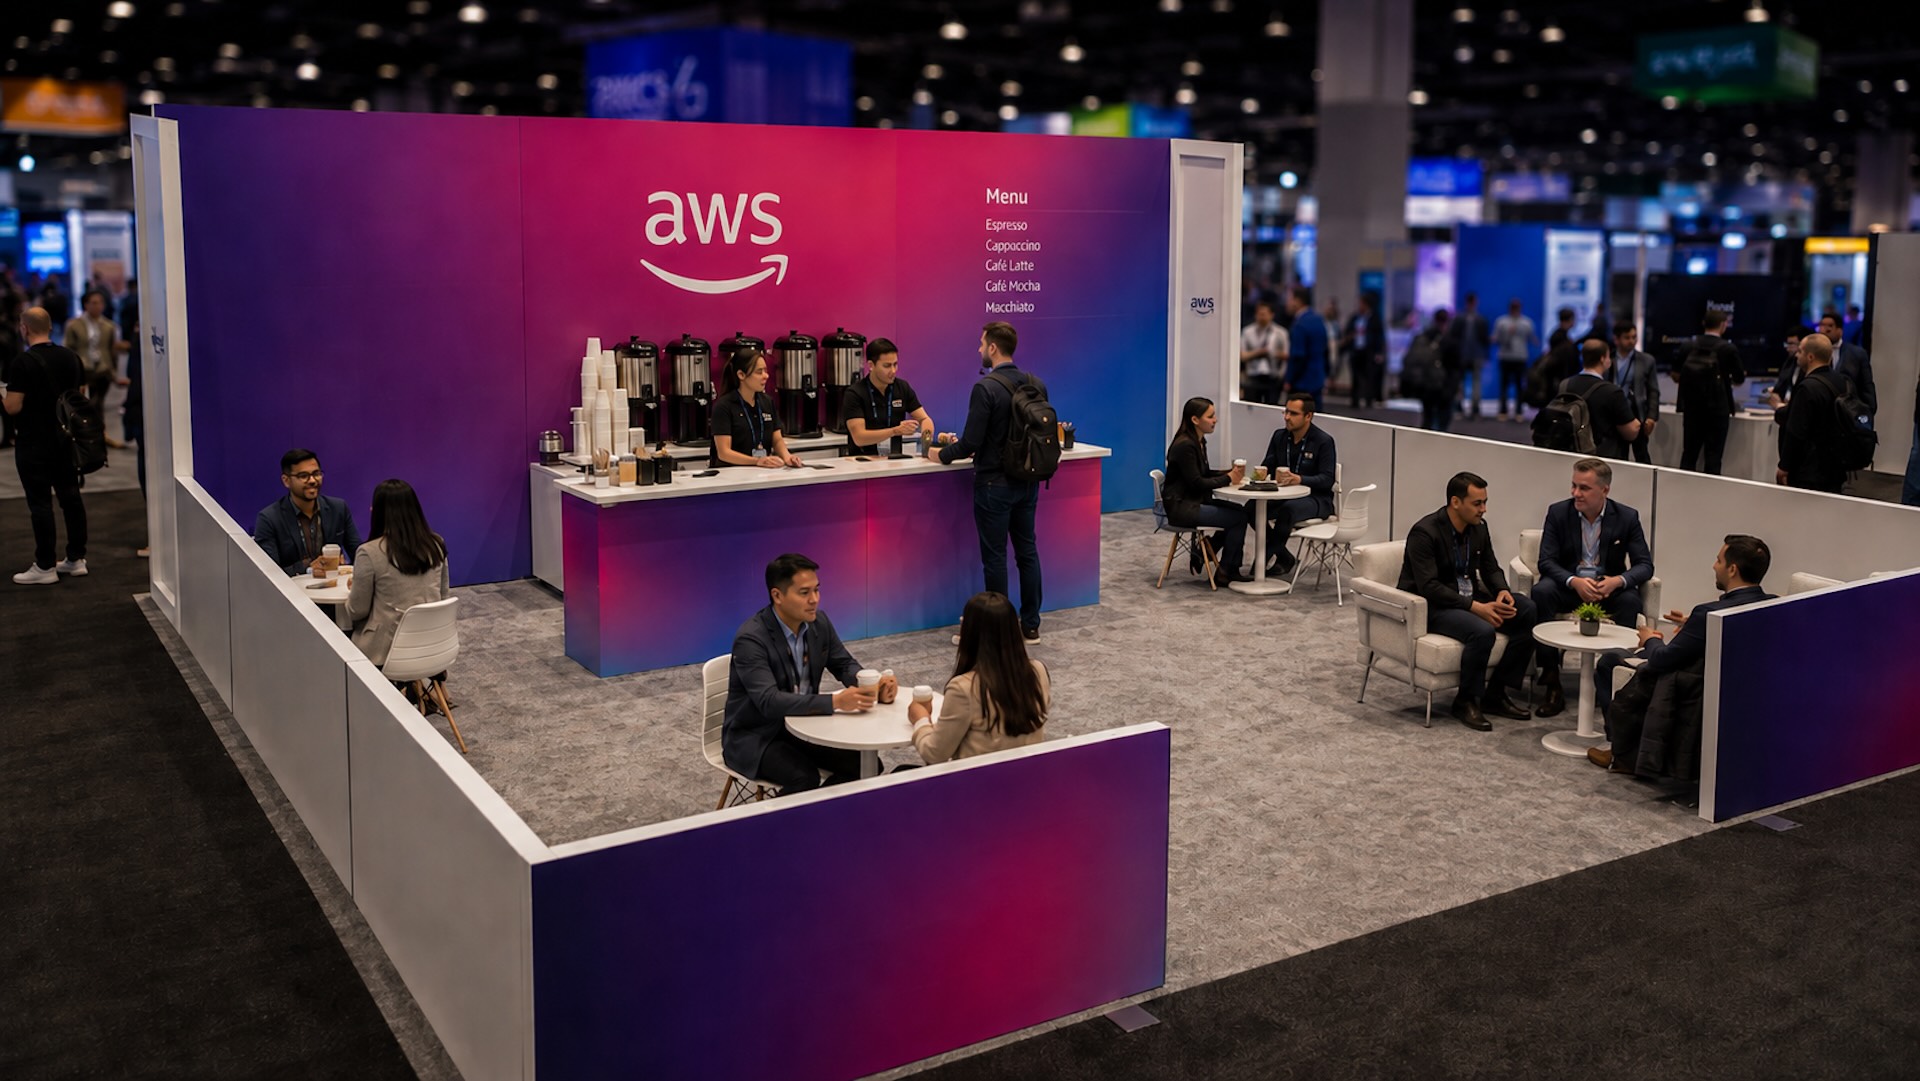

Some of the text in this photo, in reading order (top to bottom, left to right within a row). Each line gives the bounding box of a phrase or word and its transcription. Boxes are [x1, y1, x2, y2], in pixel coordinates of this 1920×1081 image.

[985, 187, 1029, 205] Menu
[644, 190, 783, 246] aws
[985, 218, 1028, 233] Espresso
[985, 258, 1035, 272] Café Latte
[985, 279, 1041, 293] Café Mocha
[985, 300, 1035, 313] Macchiato
[1190, 297, 1214, 309] aws
